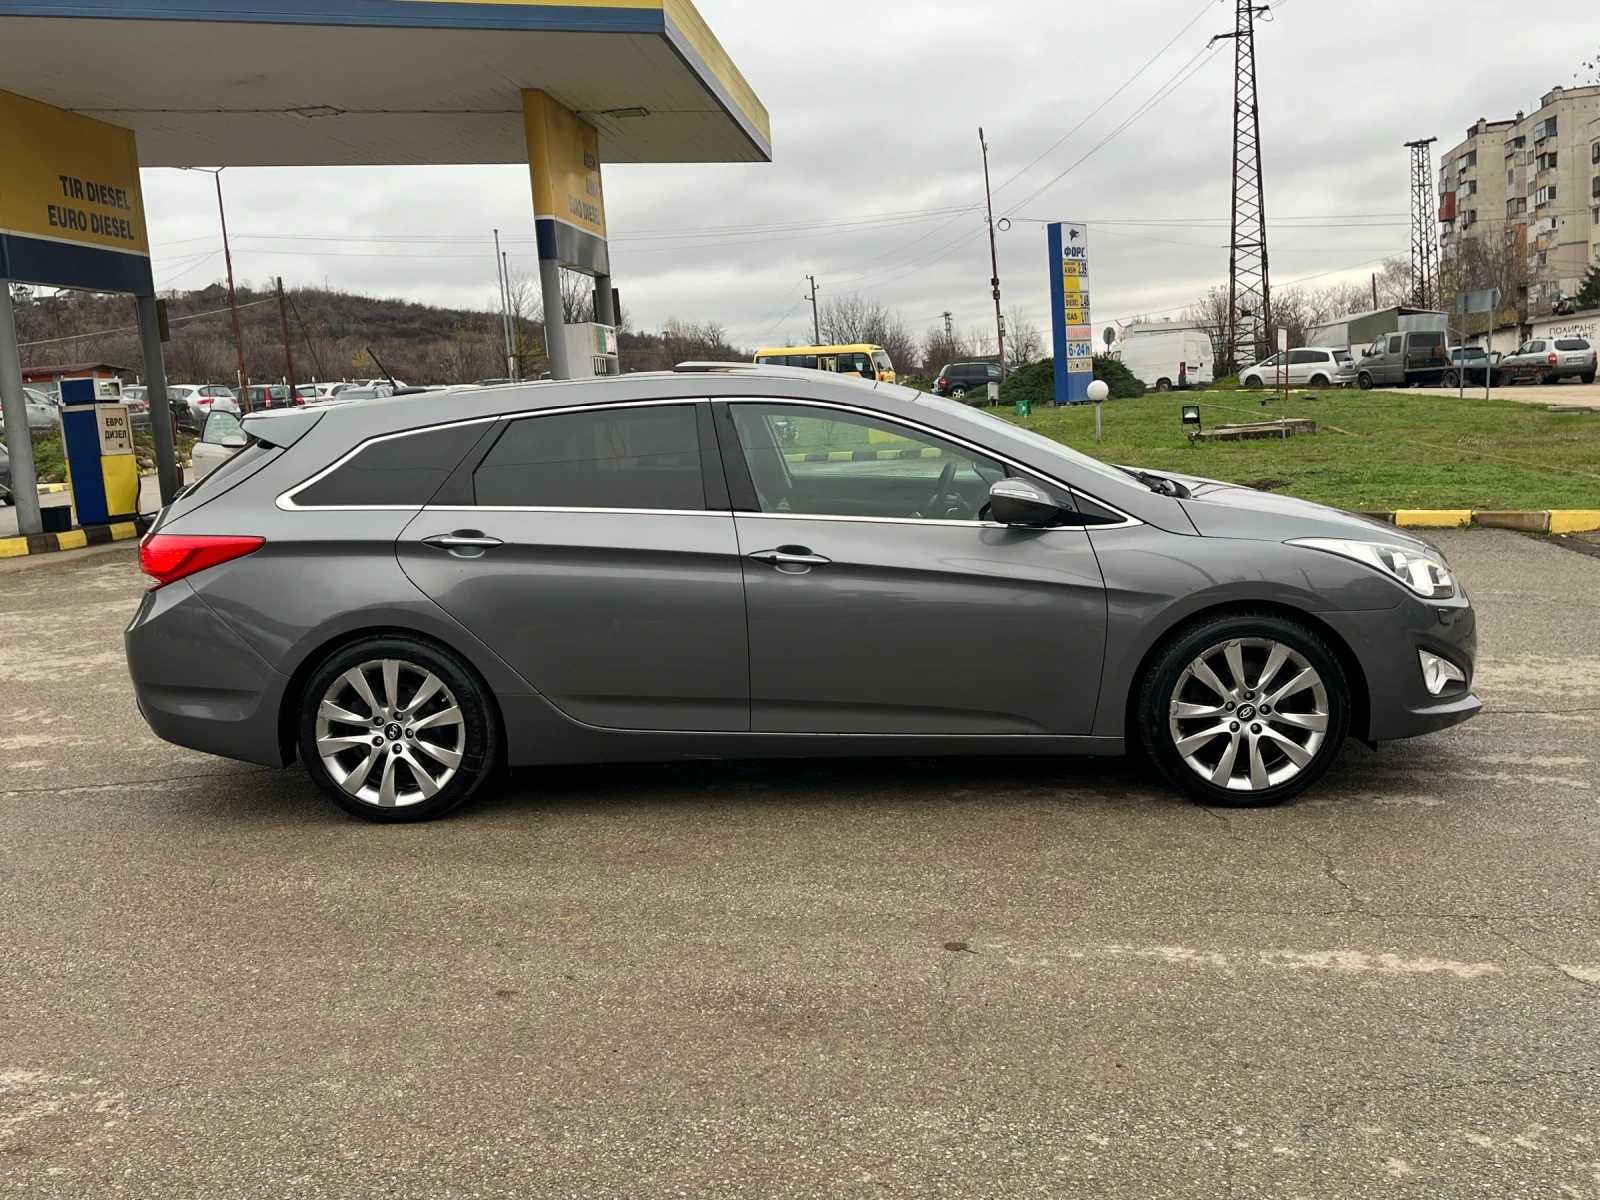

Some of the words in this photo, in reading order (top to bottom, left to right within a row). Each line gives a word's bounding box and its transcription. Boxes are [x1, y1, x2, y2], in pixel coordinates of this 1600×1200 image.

[59, 175, 84, 200] TIR
[86, 181, 131, 211] DIESEL
[47, 204, 88, 232] EURO
[90, 212, 135, 241] DIESEL
[1064, 246, 1085, 257] ФОРС
[1066, 299, 1080, 307] DIESEL
[1067, 312, 1077, 320] GAS
[1550, 323, 1597, 334] ПОЛИРАНЕ
[105, 417, 123, 427] ЕВРО
[105, 430, 127, 440] ДИЗЕЛ
